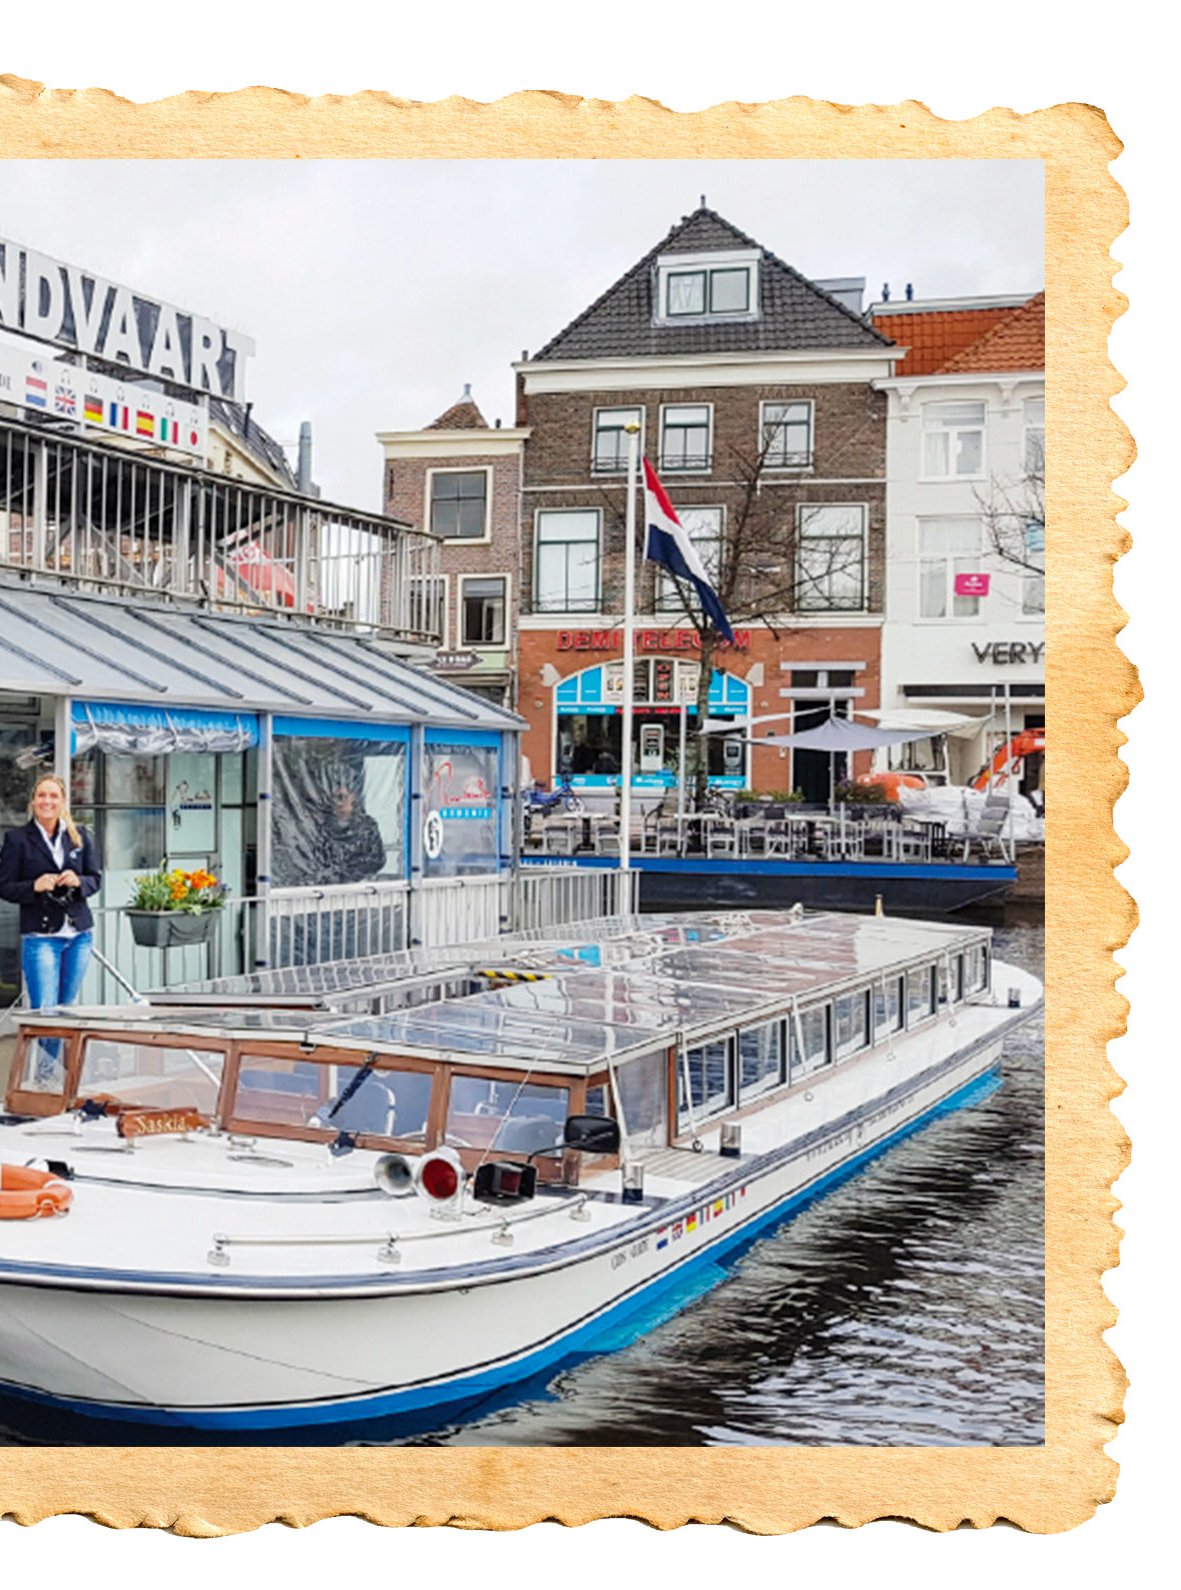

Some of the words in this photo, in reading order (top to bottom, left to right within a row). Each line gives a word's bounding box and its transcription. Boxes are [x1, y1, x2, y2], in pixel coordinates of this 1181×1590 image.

[557, 630, 620, 650] DEMI
[632, 630, 751, 650] TELECM
[970, 641, 1045, 665] VERY
[134, 1113, 186, 1135] Saskia
